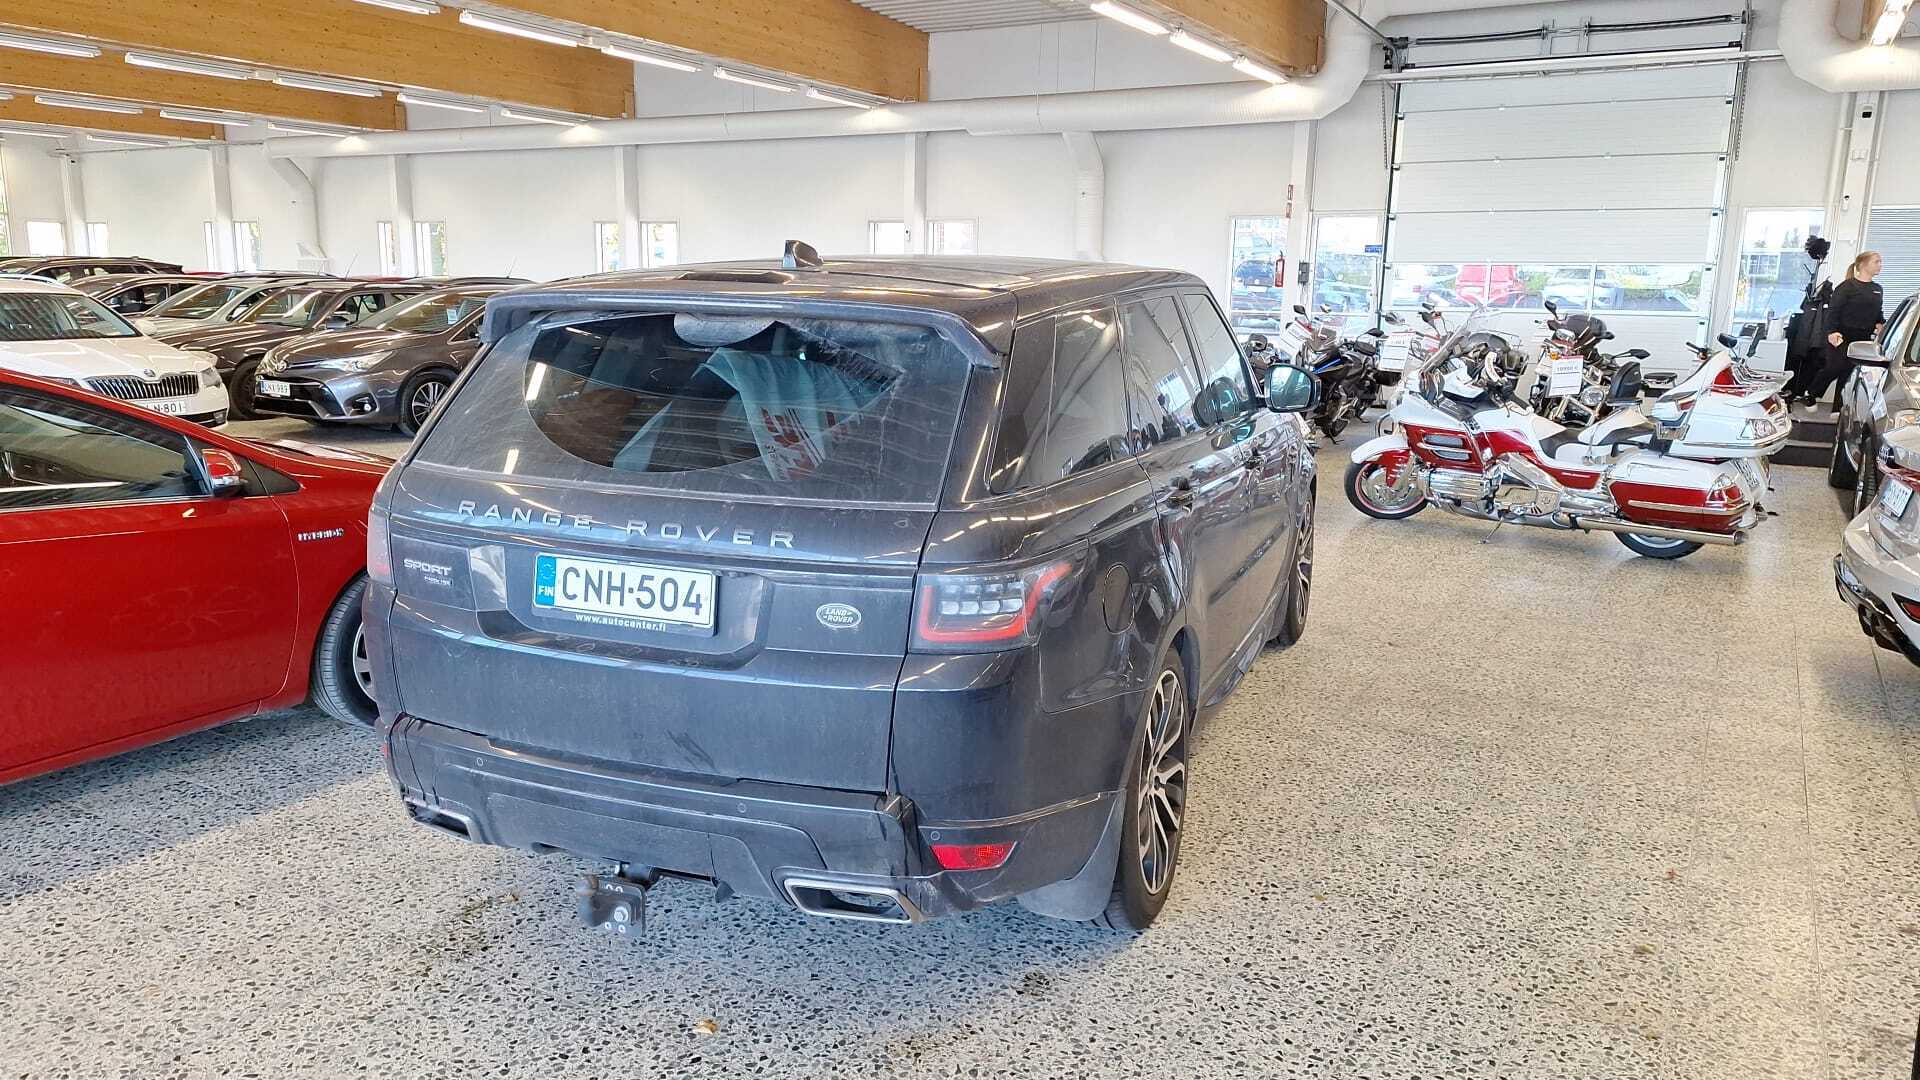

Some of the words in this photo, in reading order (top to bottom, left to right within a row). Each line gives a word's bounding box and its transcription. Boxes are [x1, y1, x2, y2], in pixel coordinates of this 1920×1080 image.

[458, 500, 593, 531] RANGE
[626, 519, 795, 549] ROVER
[403, 558, 452, 576] SPORT
[538, 585, 555, 597] FIN
[562, 566, 703, 616] CNH-504
[825, 607, 847, 616] LAND
[827, 614, 854, 623] ROVER
[575, 613, 667, 632] www.autocenter.fi
